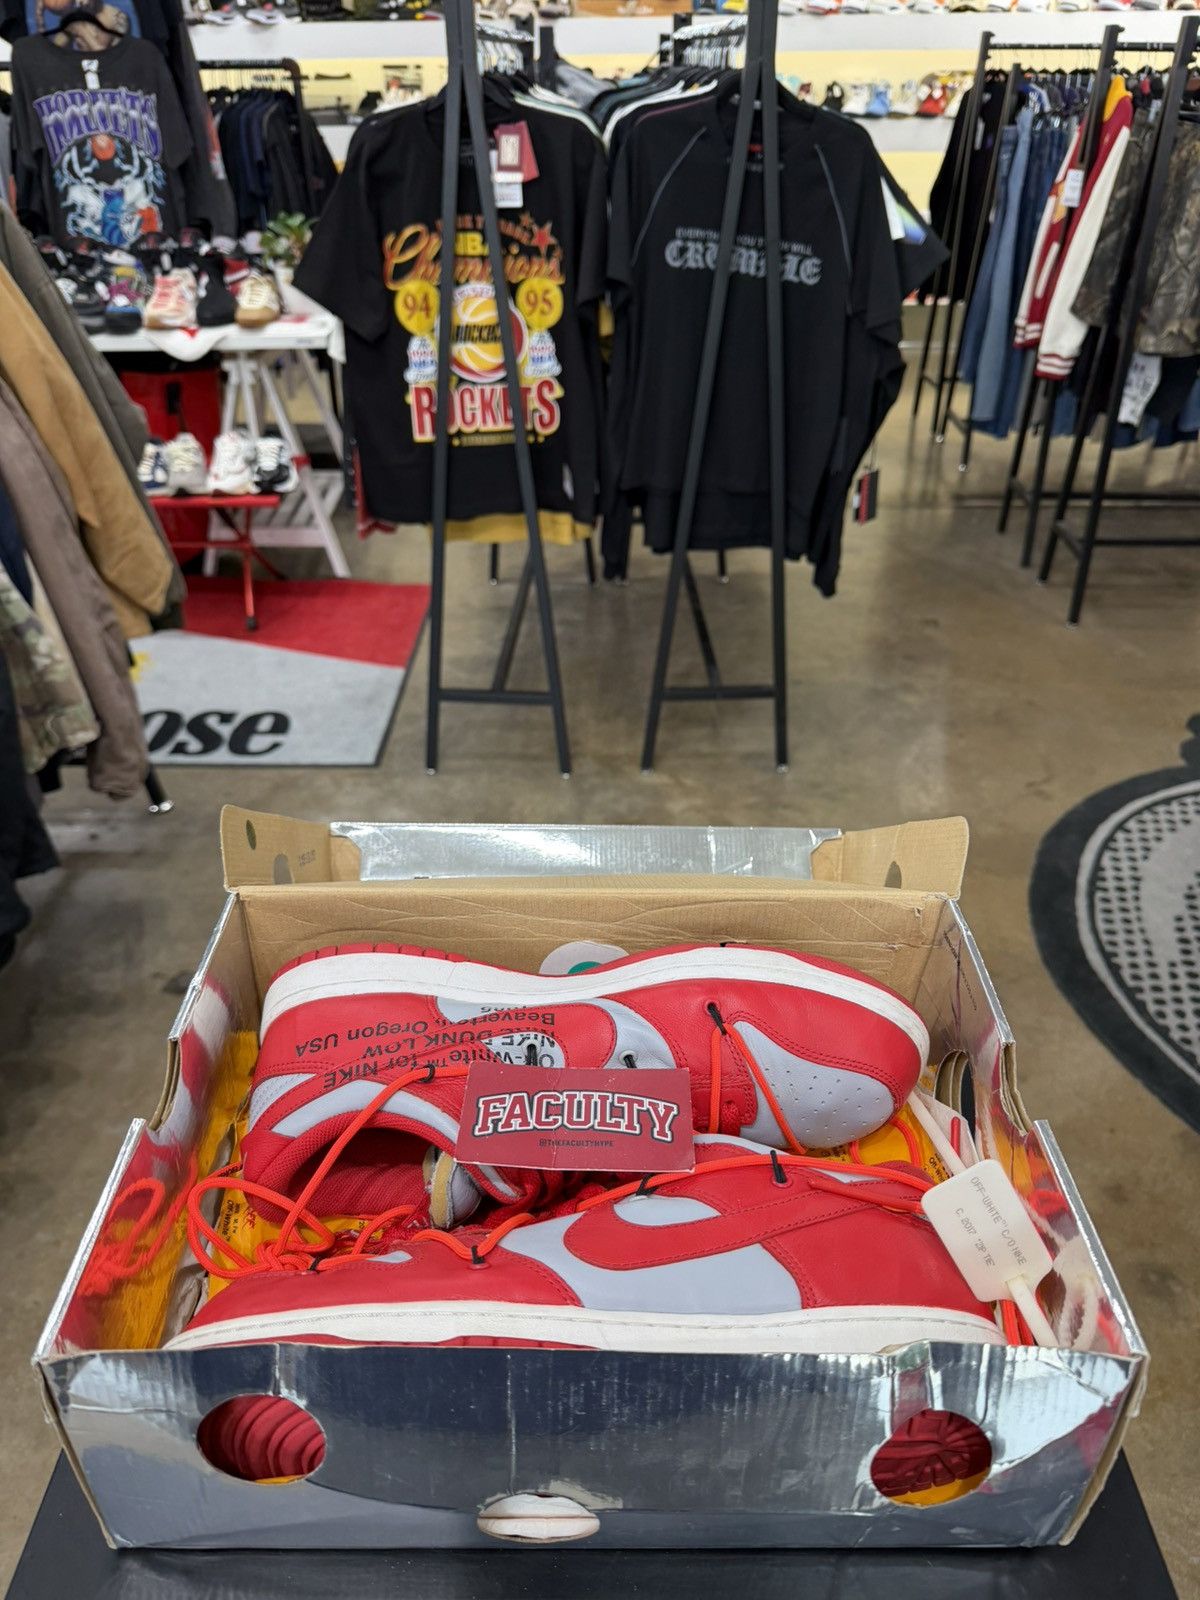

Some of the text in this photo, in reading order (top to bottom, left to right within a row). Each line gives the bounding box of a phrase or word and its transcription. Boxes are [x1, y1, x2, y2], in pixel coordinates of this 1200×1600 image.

[403, 294, 432, 321] 94
[525, 289, 556, 317] 95
[347, 1020, 429, 1041] Oregon
[295, 1034, 339, 1057] USA
[361, 1037, 416, 1059] LOW
[322, 1060, 379, 1089] NIKE
[385, 1053, 419, 1073] for
[473, 1090, 681, 1144] FACULTY
[961, 1217, 977, 1235] 2017
